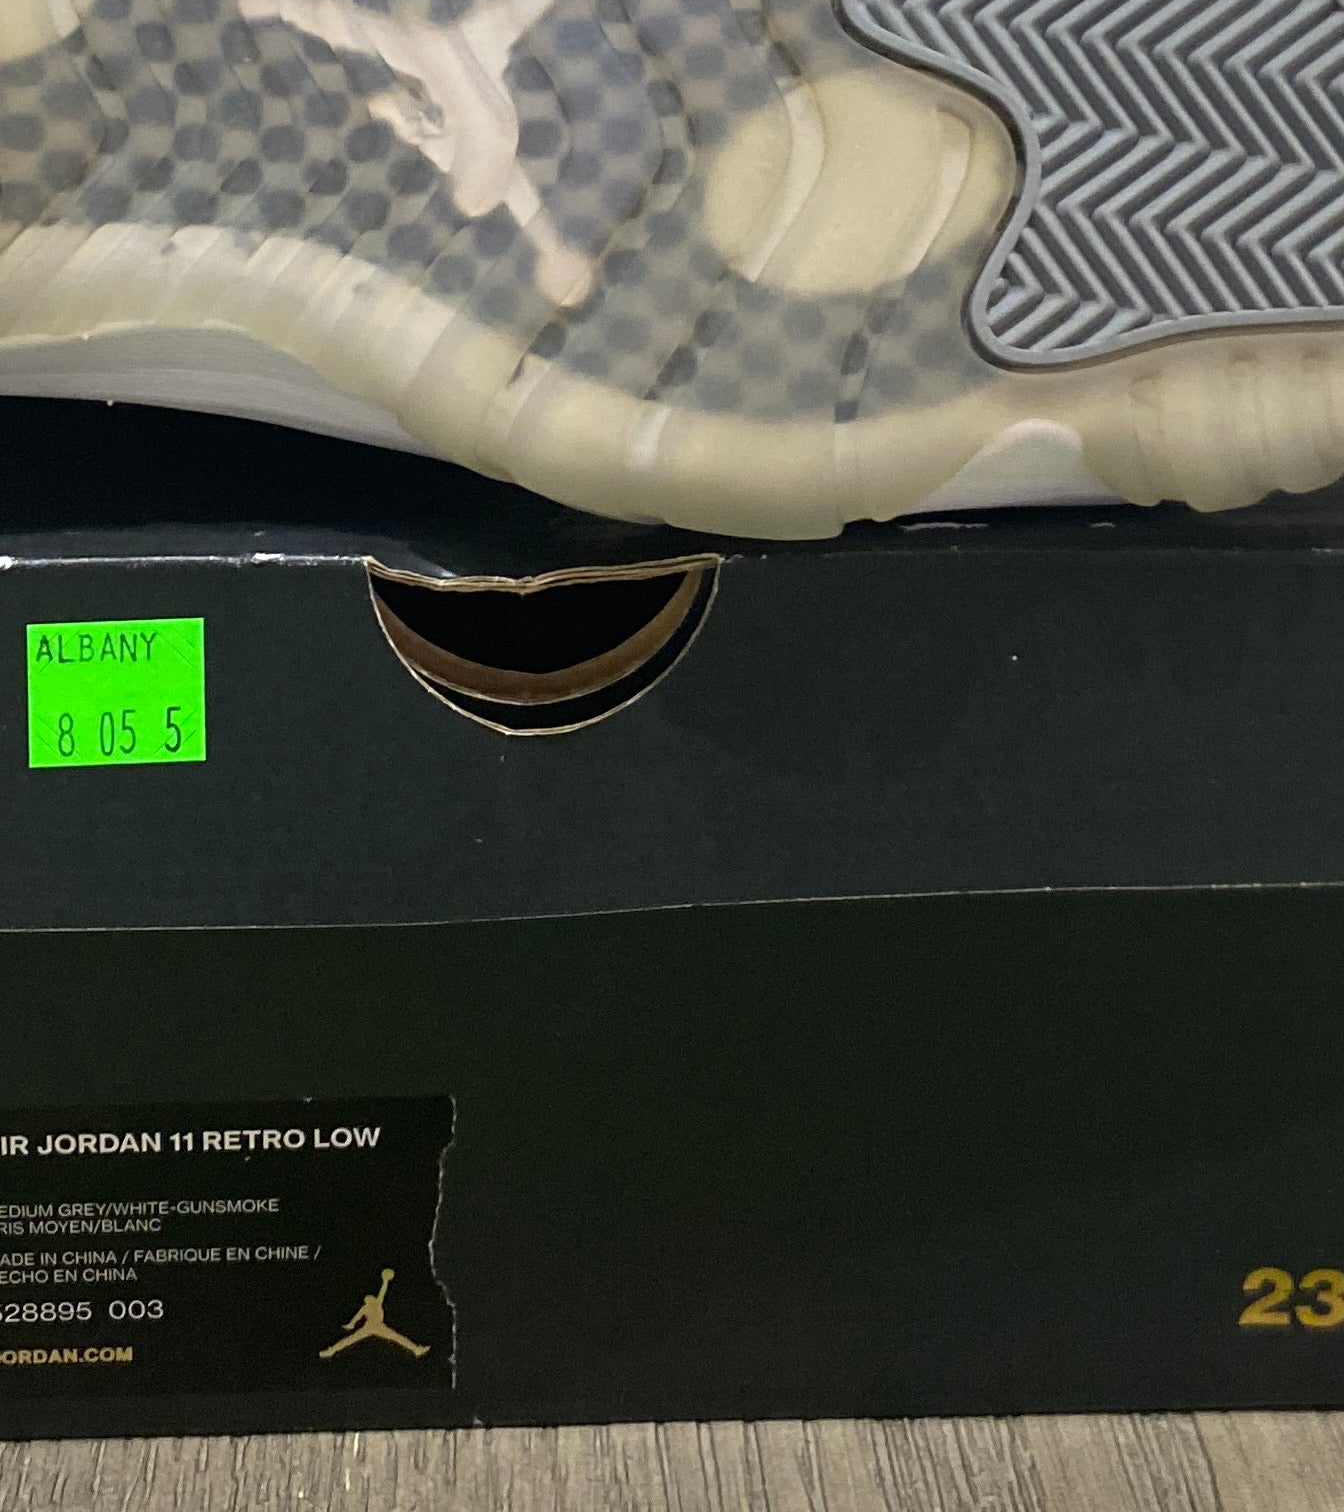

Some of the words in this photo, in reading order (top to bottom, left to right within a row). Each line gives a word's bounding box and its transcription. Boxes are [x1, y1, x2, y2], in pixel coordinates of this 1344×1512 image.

[36, 632, 156, 663] ALBANY
[58, 713, 75, 757] 8
[99, 709, 136, 756] 05
[165, 706, 181, 752] 5
[37, 1132, 161, 1155] JORDAN
[170, 1132, 193, 1153] 11
[203, 1129, 305, 1151] RETRO
[313, 1127, 381, 1149] LOW
[58, 1199, 280, 1218] GREY/WHITE-GUNSMOKE
[29, 1218, 162, 1235] MOYEN/BLANC
[40, 1252, 57, 1265] IN
[62, 1250, 118, 1265] CHINA
[121, 1250, 130, 1265] /
[134, 1247, 222, 1263] FABRIQUE
[226, 1247, 250, 1261] EN
[255, 1246, 310, 1260] CHINE
[313, 1246, 322, 1260] /
[54, 1269, 77, 1283] EN
[82, 1268, 138, 1282] CHINA
[109, 1299, 164, 1320] 003
